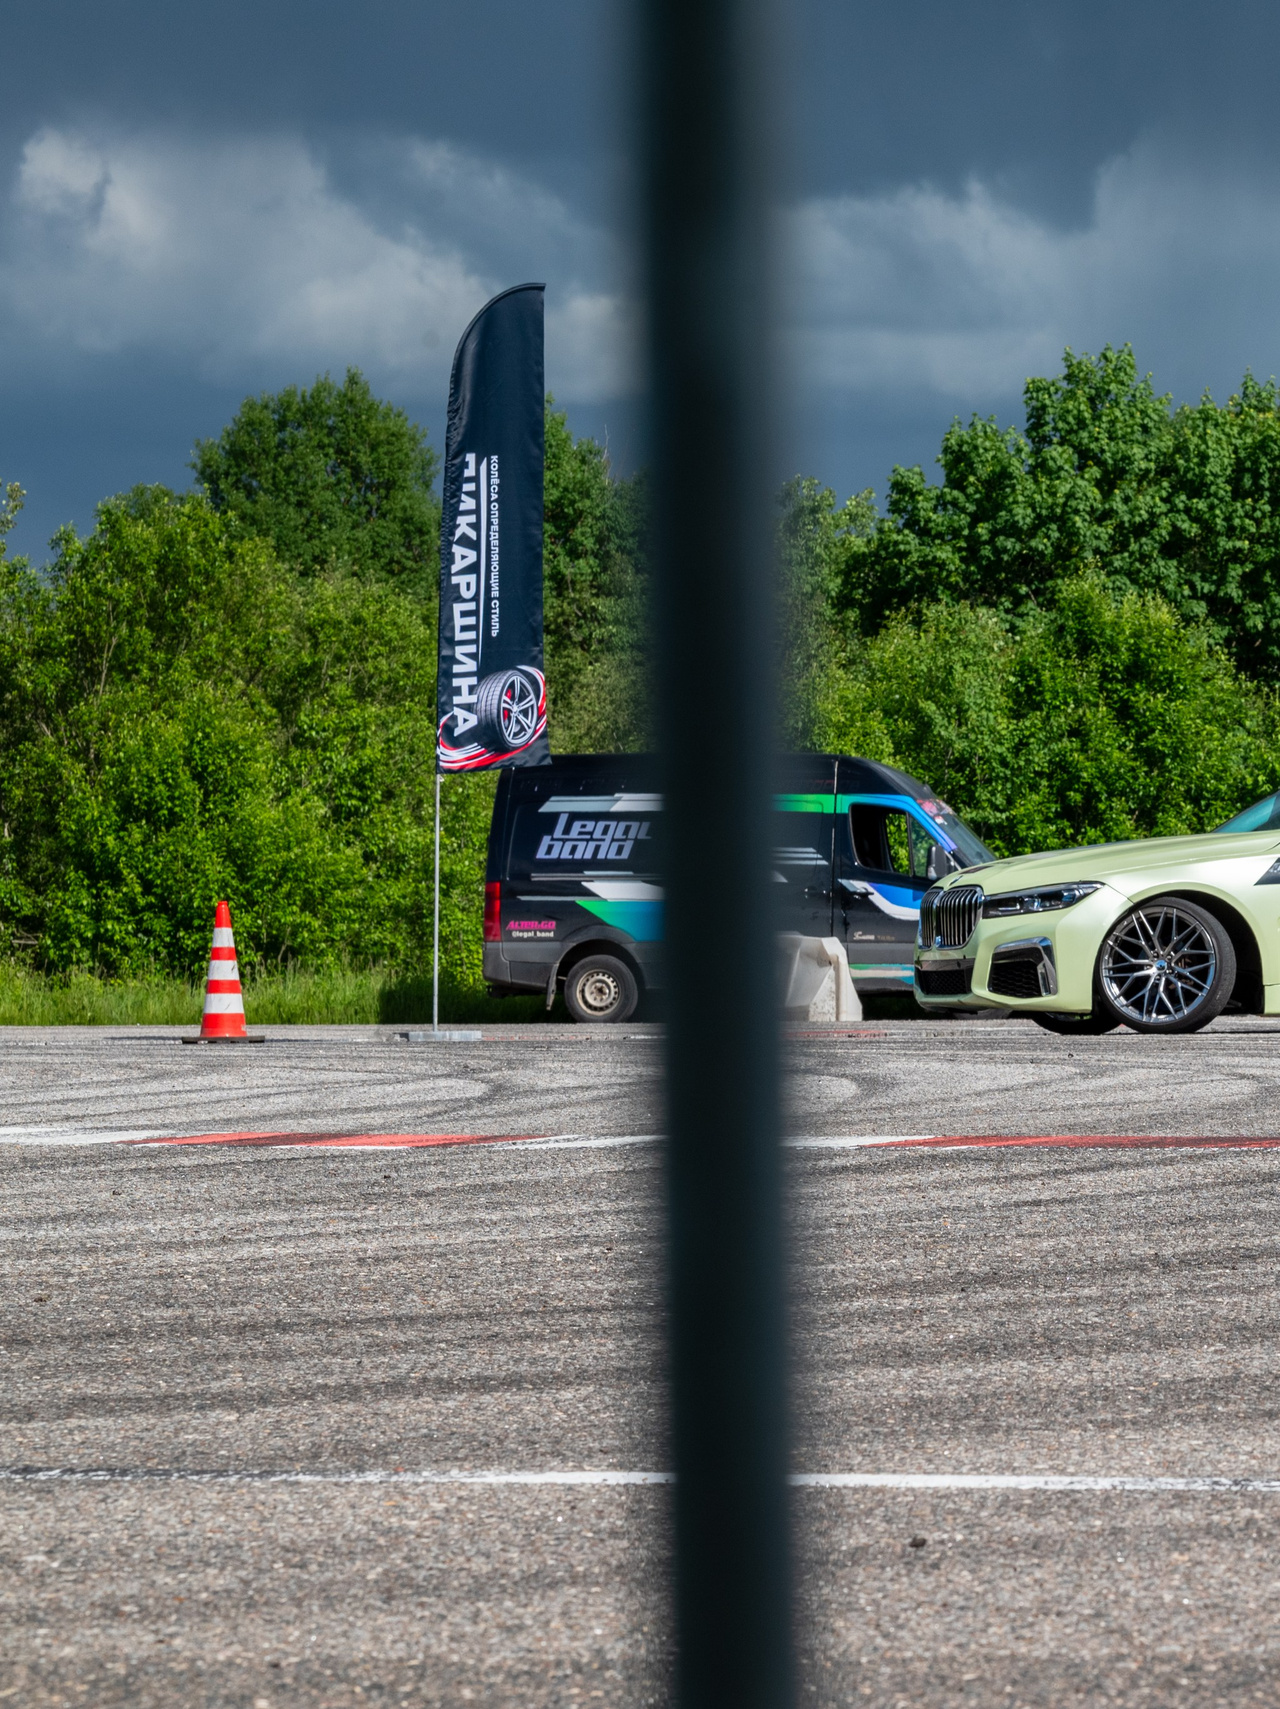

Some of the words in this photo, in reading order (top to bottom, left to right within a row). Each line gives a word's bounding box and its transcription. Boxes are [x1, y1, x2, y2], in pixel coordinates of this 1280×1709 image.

[490, 455, 500, 501] КОЛЁСА
[490, 502, 500, 598] ОПРЕДЕЛЯЮЩИЕ
[490, 600, 499, 638] СТИЛЬ
